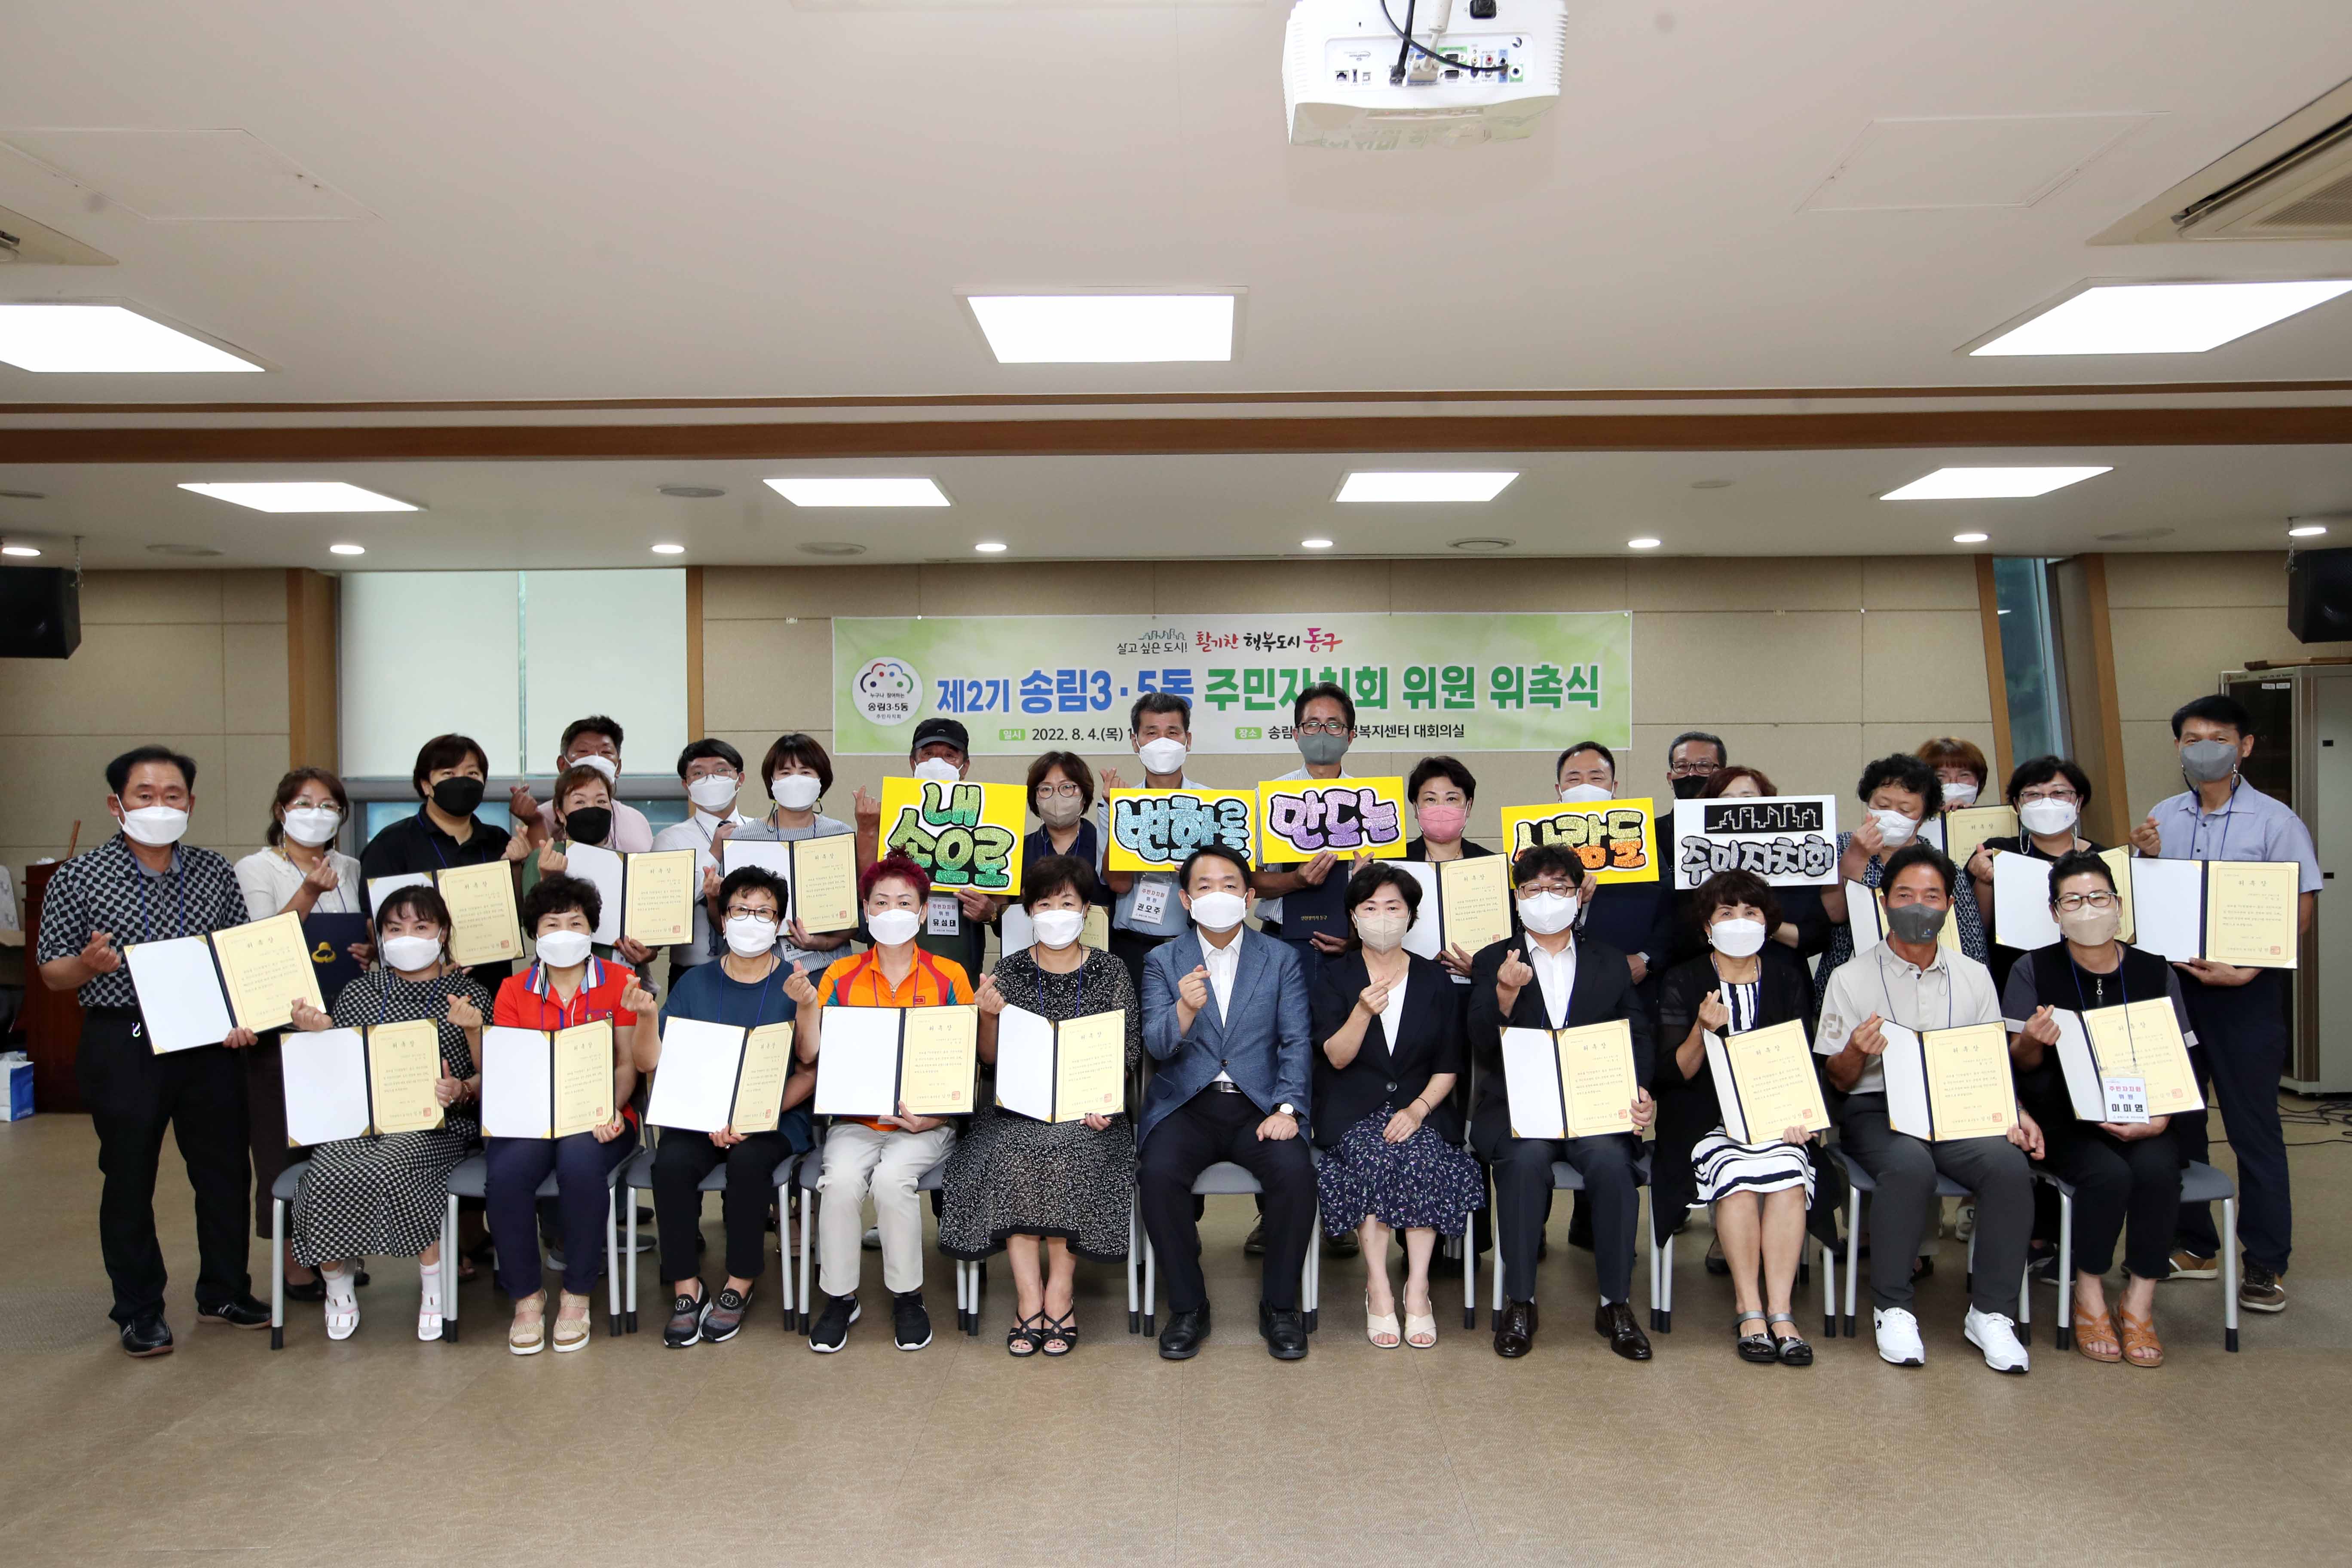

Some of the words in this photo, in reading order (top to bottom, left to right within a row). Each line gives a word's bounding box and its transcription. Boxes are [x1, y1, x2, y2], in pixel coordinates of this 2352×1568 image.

[1196, 631, 1239, 652] 활기찬
[1244, 632, 1300, 652] 행복도시
[1303, 628, 1343, 652] 동구
[1117, 643, 1138, 654] 살고
[1140, 642, 1161, 654] 싶은
[1163, 641, 1188, 653] 도시!
[937, 679, 1009, 713] 제2기
[1403, 666, 1475, 709] 위원
[1491, 665, 1598, 709] 위촉식
[868, 702, 908, 711] 송림3·5동
[1003, 730, 1021, 740] 일시
[1032, 729, 1068, 741] 2022.
[1072, 729, 1084, 741] 8.
[1088, 728, 1123, 741] 4.(목)
[1238, 729, 1258, 738] 장소
[1414, 724, 1464, 738] 대회의실
[922, 783, 981, 828] 내
[1270, 788, 1401, 849] 만드는
[1115, 795, 1251, 861] 변화를
[1137, 903, 1161, 914] 권오주
[2111, 1103, 2144, 1112] 이미영
